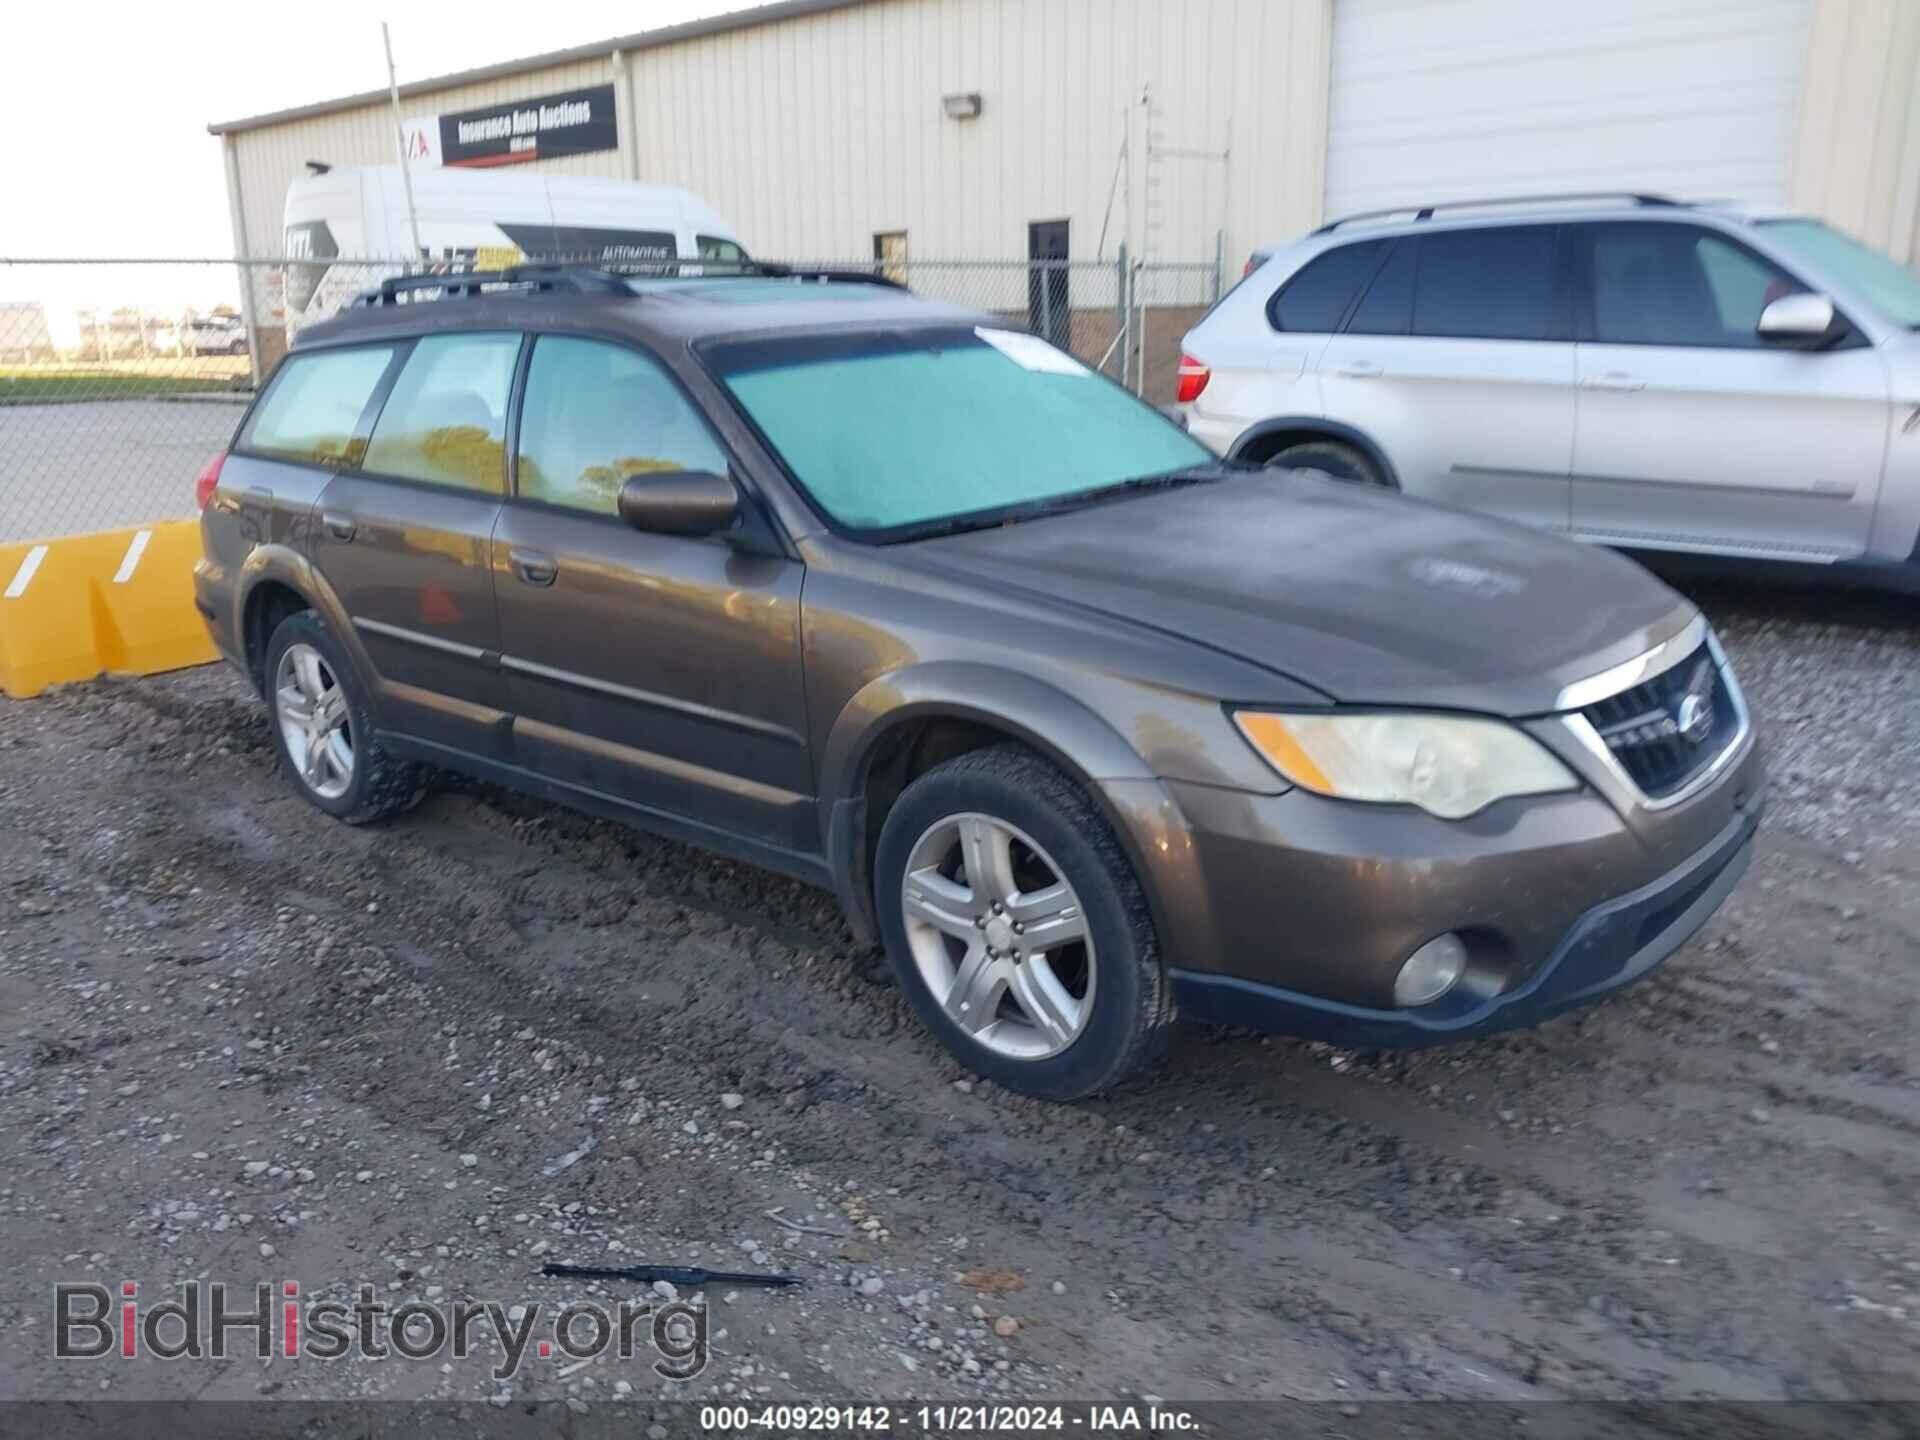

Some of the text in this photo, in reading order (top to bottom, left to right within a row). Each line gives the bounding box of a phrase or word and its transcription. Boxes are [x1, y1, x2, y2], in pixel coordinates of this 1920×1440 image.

[458, 100, 591, 144] Insurance Auto Auctions
